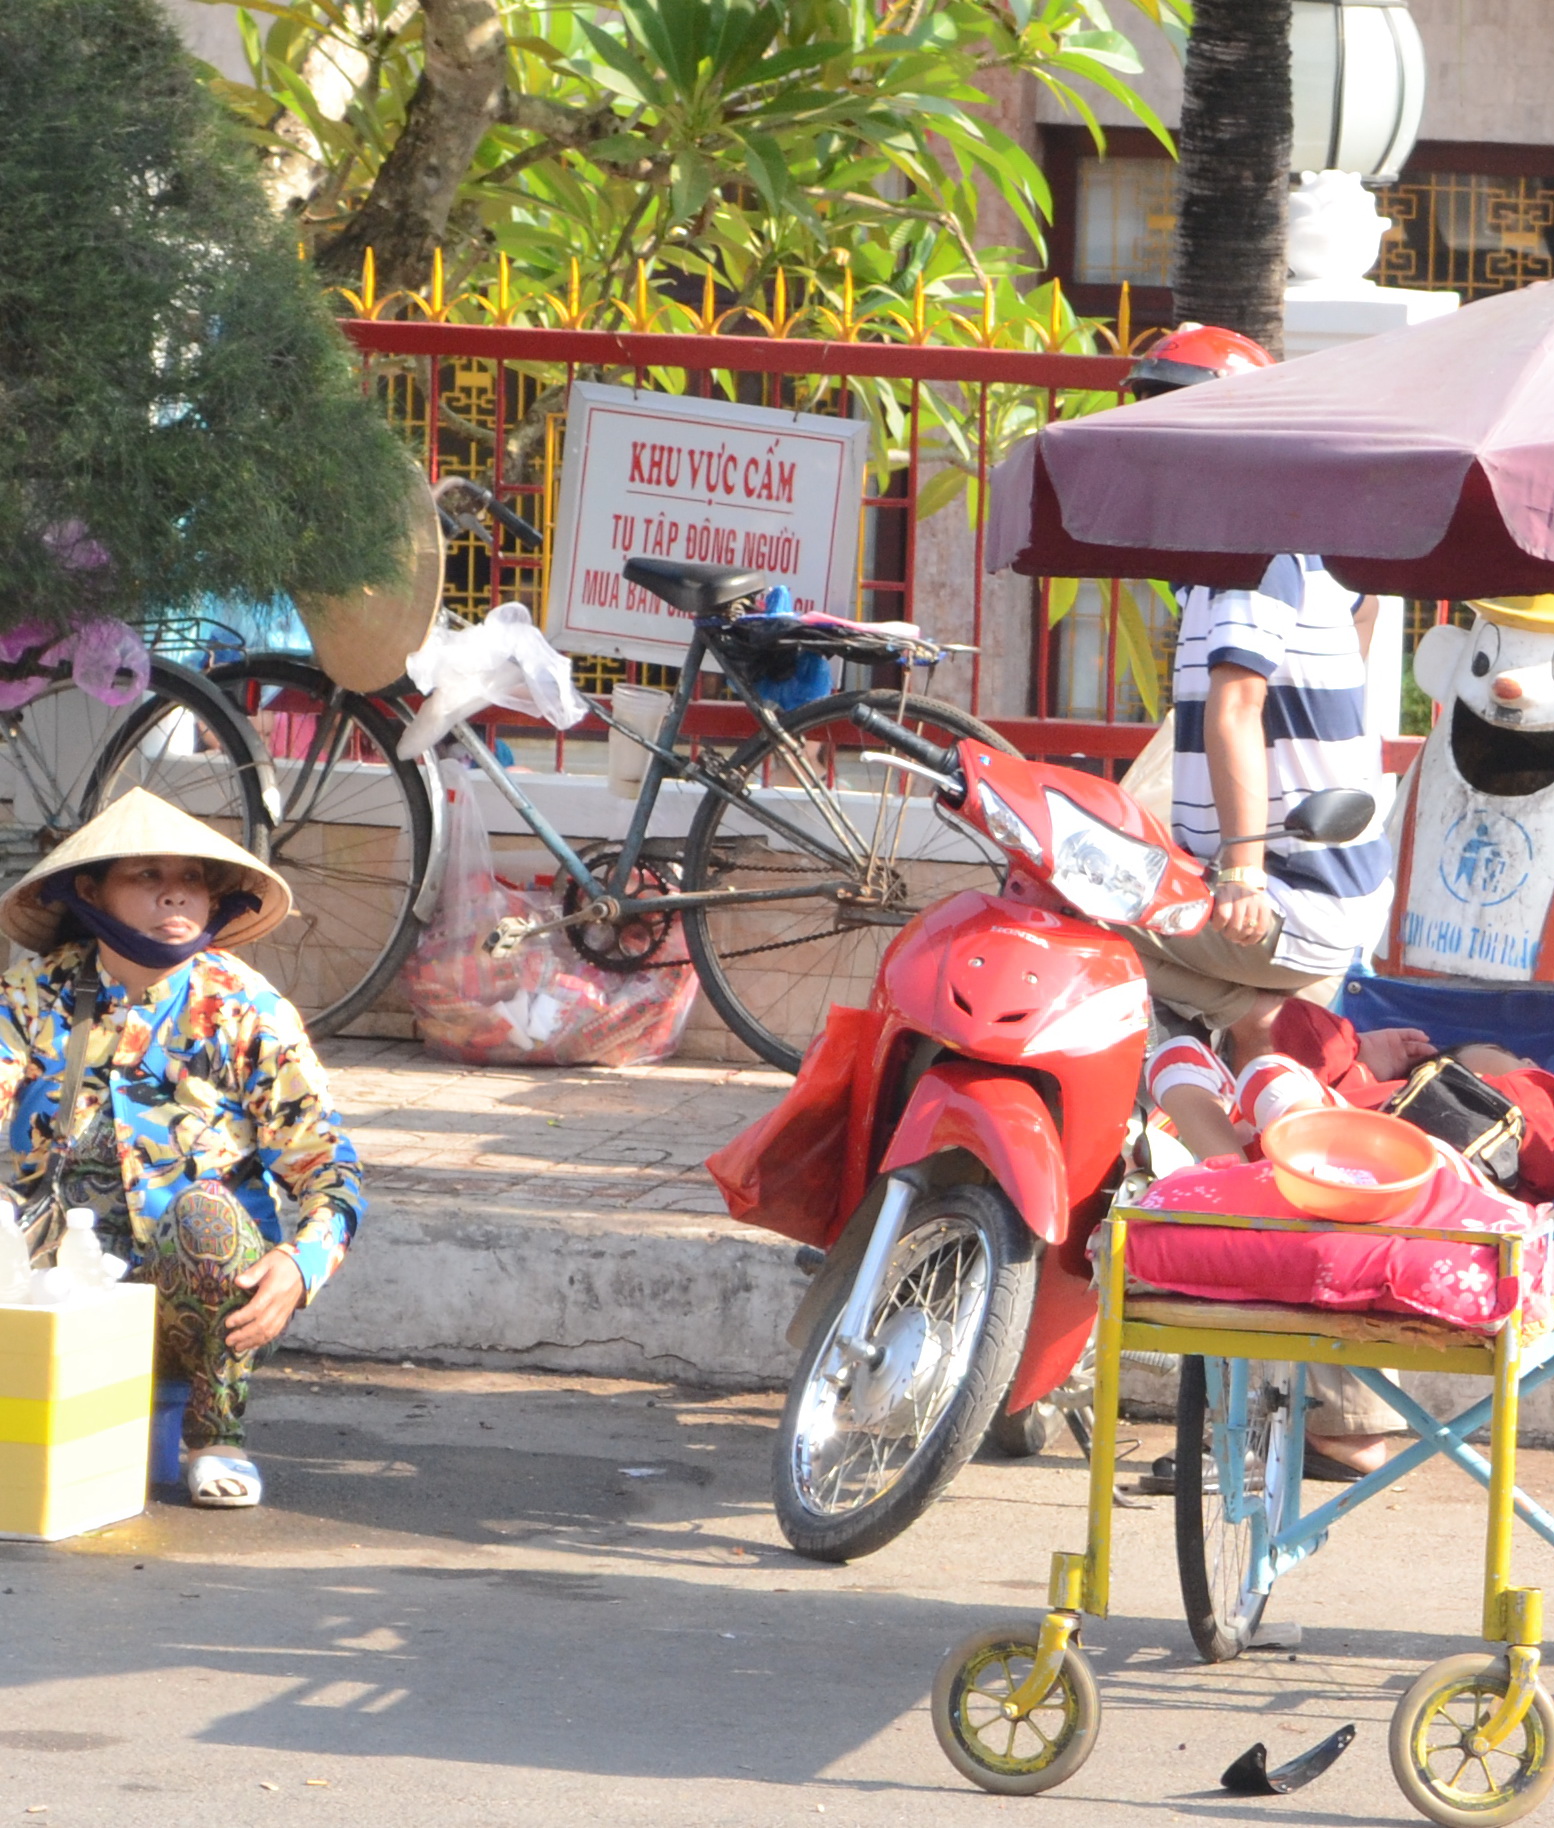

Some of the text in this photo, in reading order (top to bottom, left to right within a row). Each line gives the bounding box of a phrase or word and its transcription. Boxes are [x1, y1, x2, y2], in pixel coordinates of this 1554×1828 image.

[629, 438, 796, 505] KHU VỰC CẤM
[612, 513, 635, 562] TỤ
[685, 517, 737, 566] ĐÔNG
[741, 527, 801, 575] NGƯỜI
[581, 569, 619, 609] MUA
[990, 925, 1049, 950] HONDA
